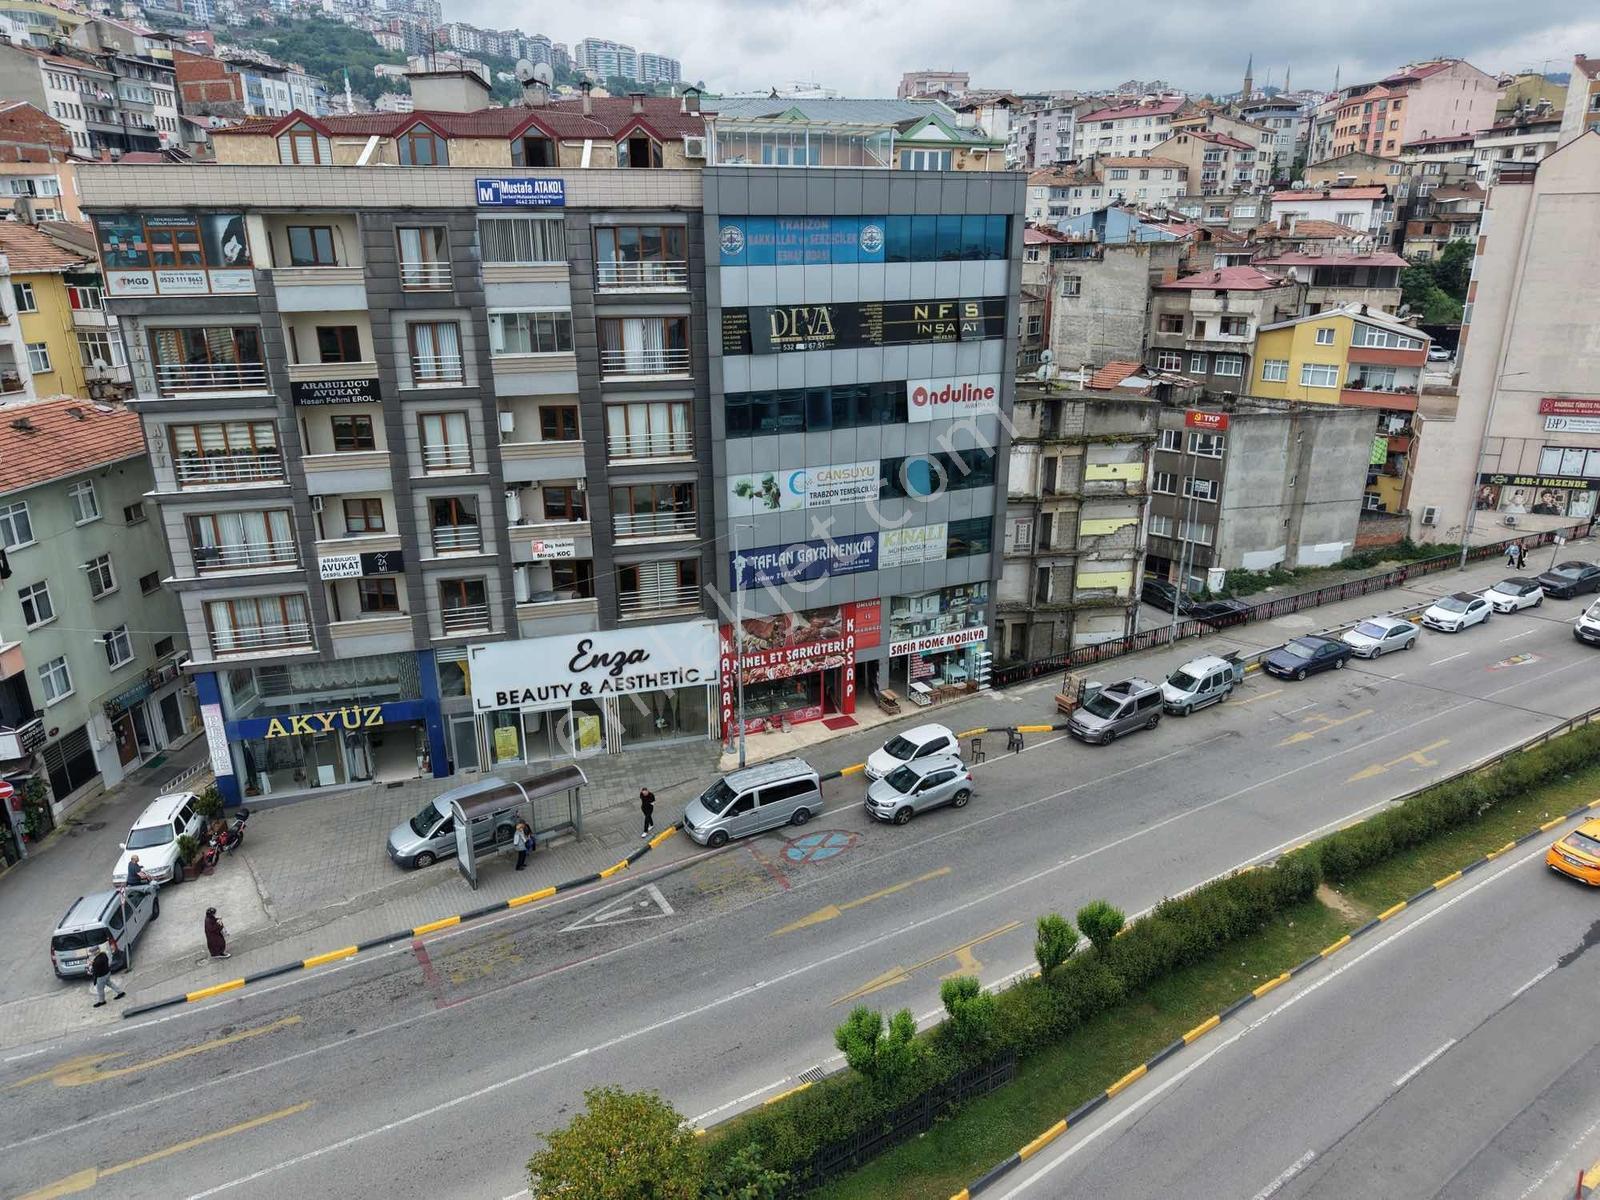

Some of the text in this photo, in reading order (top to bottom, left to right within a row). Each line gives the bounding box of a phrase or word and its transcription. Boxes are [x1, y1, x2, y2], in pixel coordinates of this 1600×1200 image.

[501, 181, 563, 194] Mustafa ATAKOL
[121, 277, 149, 286] TMGD
[301, 380, 369, 390] ARABULUCU
[313, 388, 360, 397] AVUKAT
[326, 396, 351, 404] Fehmi
[352, 395, 375, 403] EROL
[912, 383, 995, 407] Onduline
[1204, 414, 1220, 422] TKP
[816, 465, 875, 481] CANSUYU
[1541, 480, 1588, 488] NAZENDE
[809, 489, 839, 499] TRABZON
[321, 561, 359, 572] AVUKAT
[750, 551, 794, 569] TAFLAN
[918, 636, 945, 650] HOME
[946, 628, 984, 645] MOBİLYA
[568, 638, 652, 677] Enza
[770, 651, 783, 664] ET
[786, 639, 845, 661] ŞARKÜTERİ
[846, 618, 855, 697] KASAP
[720, 640, 731, 723] KASAP
[496, 682, 573, 707] BEAUTY
[579, 681, 593, 696] &
[264, 704, 384, 739] AKYÜZ
